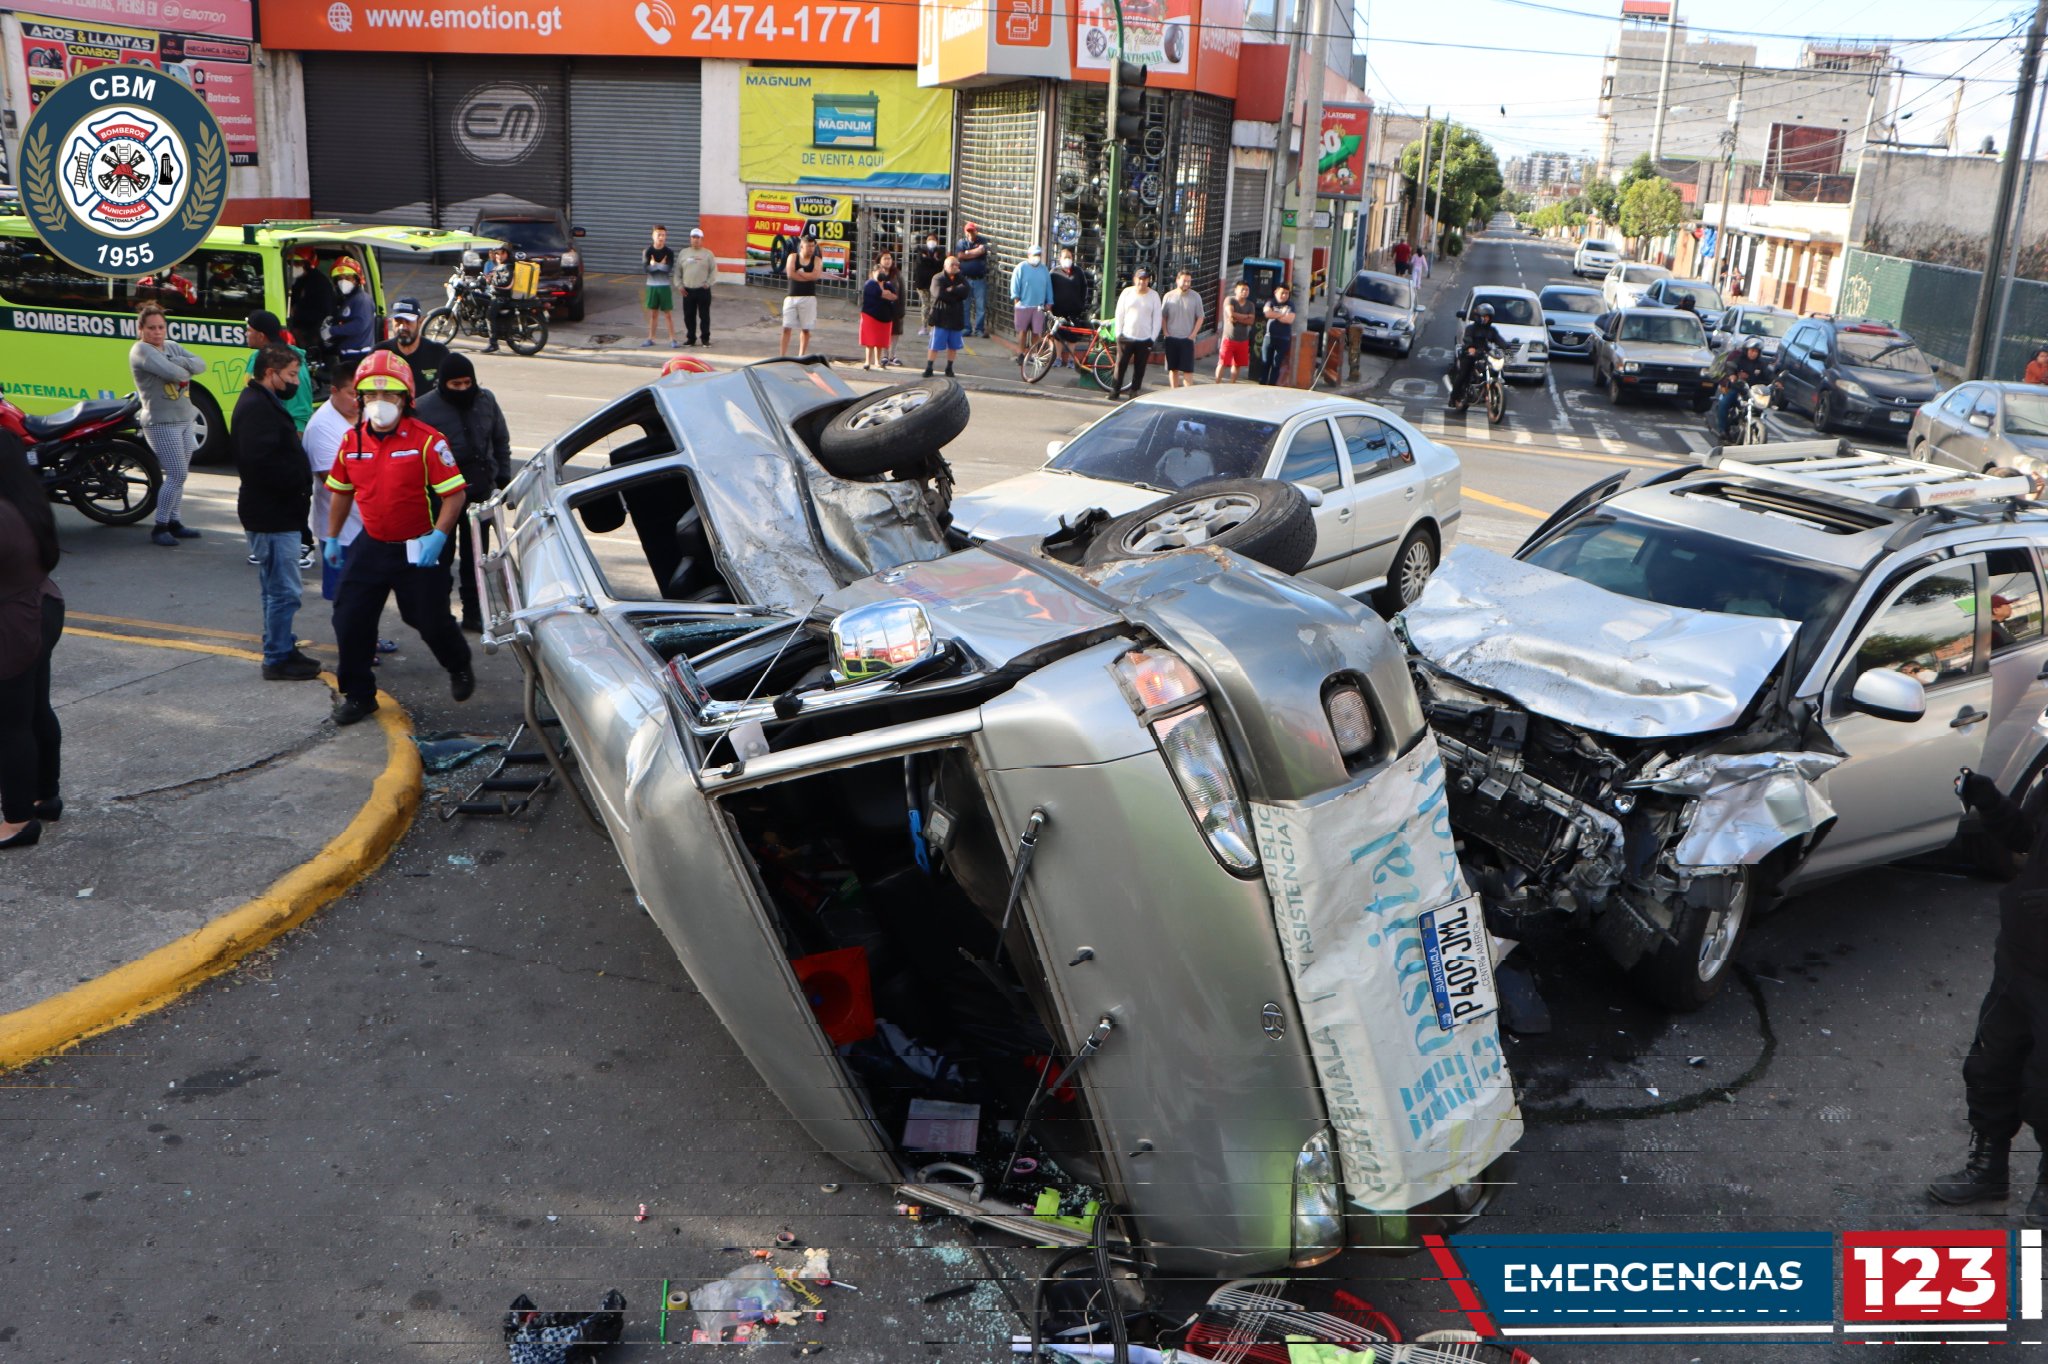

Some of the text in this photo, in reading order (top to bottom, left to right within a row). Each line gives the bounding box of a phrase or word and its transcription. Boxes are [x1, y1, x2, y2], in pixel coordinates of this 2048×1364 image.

[365, 5, 562, 36] www.emotion.gt
[691, 4, 881, 43] 2474-1771
[30, 25, 75, 41] AROS
[77, 31, 87, 43] &
[88, 33, 151, 50] LLANTAS
[68, 45, 119, 58] COMBOS
[206, 72, 233, 83] Frenos
[745, 76, 812, 87] MAGNUM
[1327, 111, 1357, 120] LATORRE
[818, 119, 872, 131] MAGNUM
[802, 152, 884, 167] DE VENTA AQUÍ
[799, 203, 833, 214] MOTO
[755, 221, 770, 231] ARO
[771, 222, 781, 231] 17
[817, 221, 844, 239] 139
[13, 311, 247, 345] BOMBEROS MCIPALES
[0, 382, 90, 400] UATEMALA
[1275, 823, 1315, 954] ASISTENCIA
